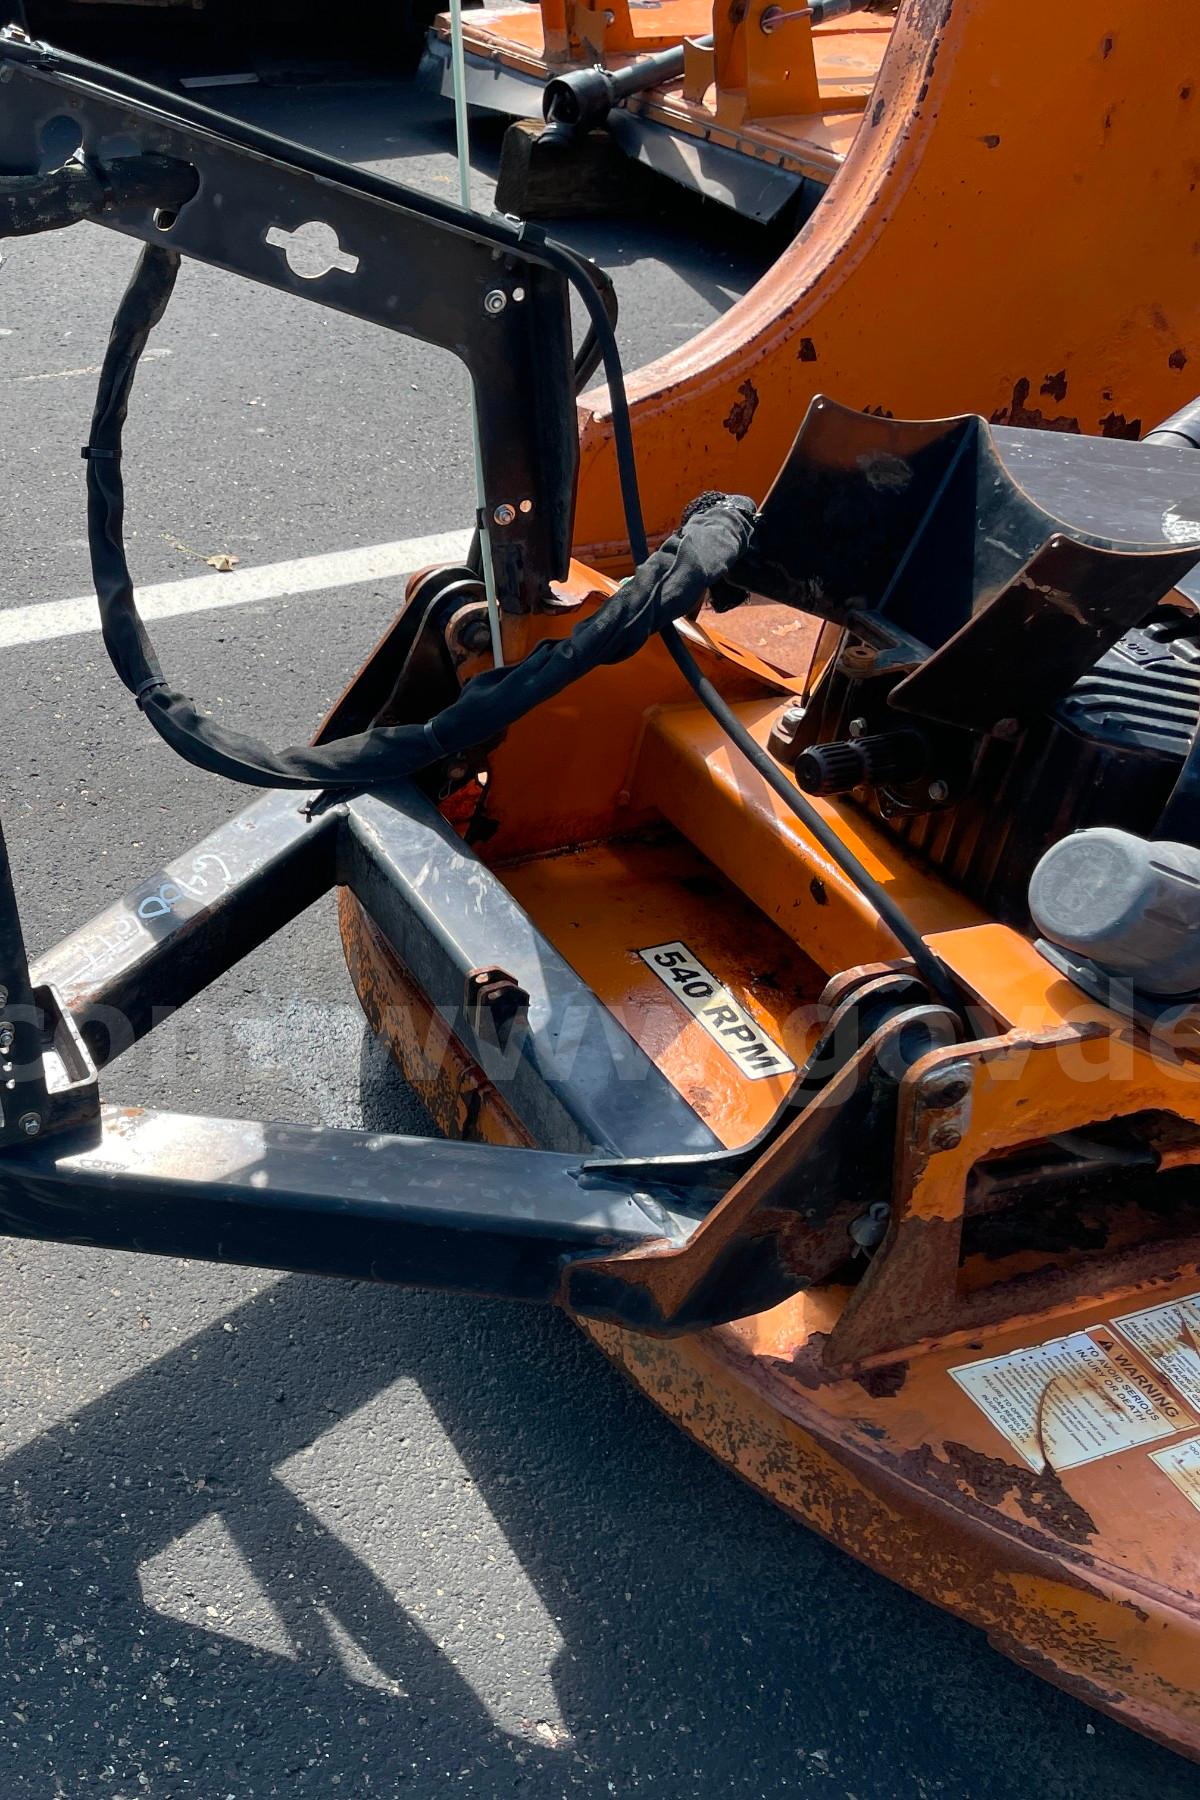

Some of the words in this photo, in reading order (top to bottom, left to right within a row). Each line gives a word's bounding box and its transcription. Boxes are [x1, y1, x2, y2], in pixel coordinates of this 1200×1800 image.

[654, 951, 714, 999] 540
[703, 1004, 782, 1070] RPM
[1073, 1349, 1107, 1378] INJURY
[1102, 1378, 1120, 1392] OR
[1084, 1345, 1101, 1357] TO
[1095, 1358, 1125, 1383] AVOID
[1120, 1384, 1161, 1421] SERIOUS
[1115, 1354, 1179, 1417] WARNING
[979, 1394, 1002, 1414] INJURY
[997, 1414, 1010, 1423] OR
[991, 1397, 1006, 1409] CAN
[1001, 1409, 1026, 1431] RESULT
[1002, 1398, 1012, 1406] TO
